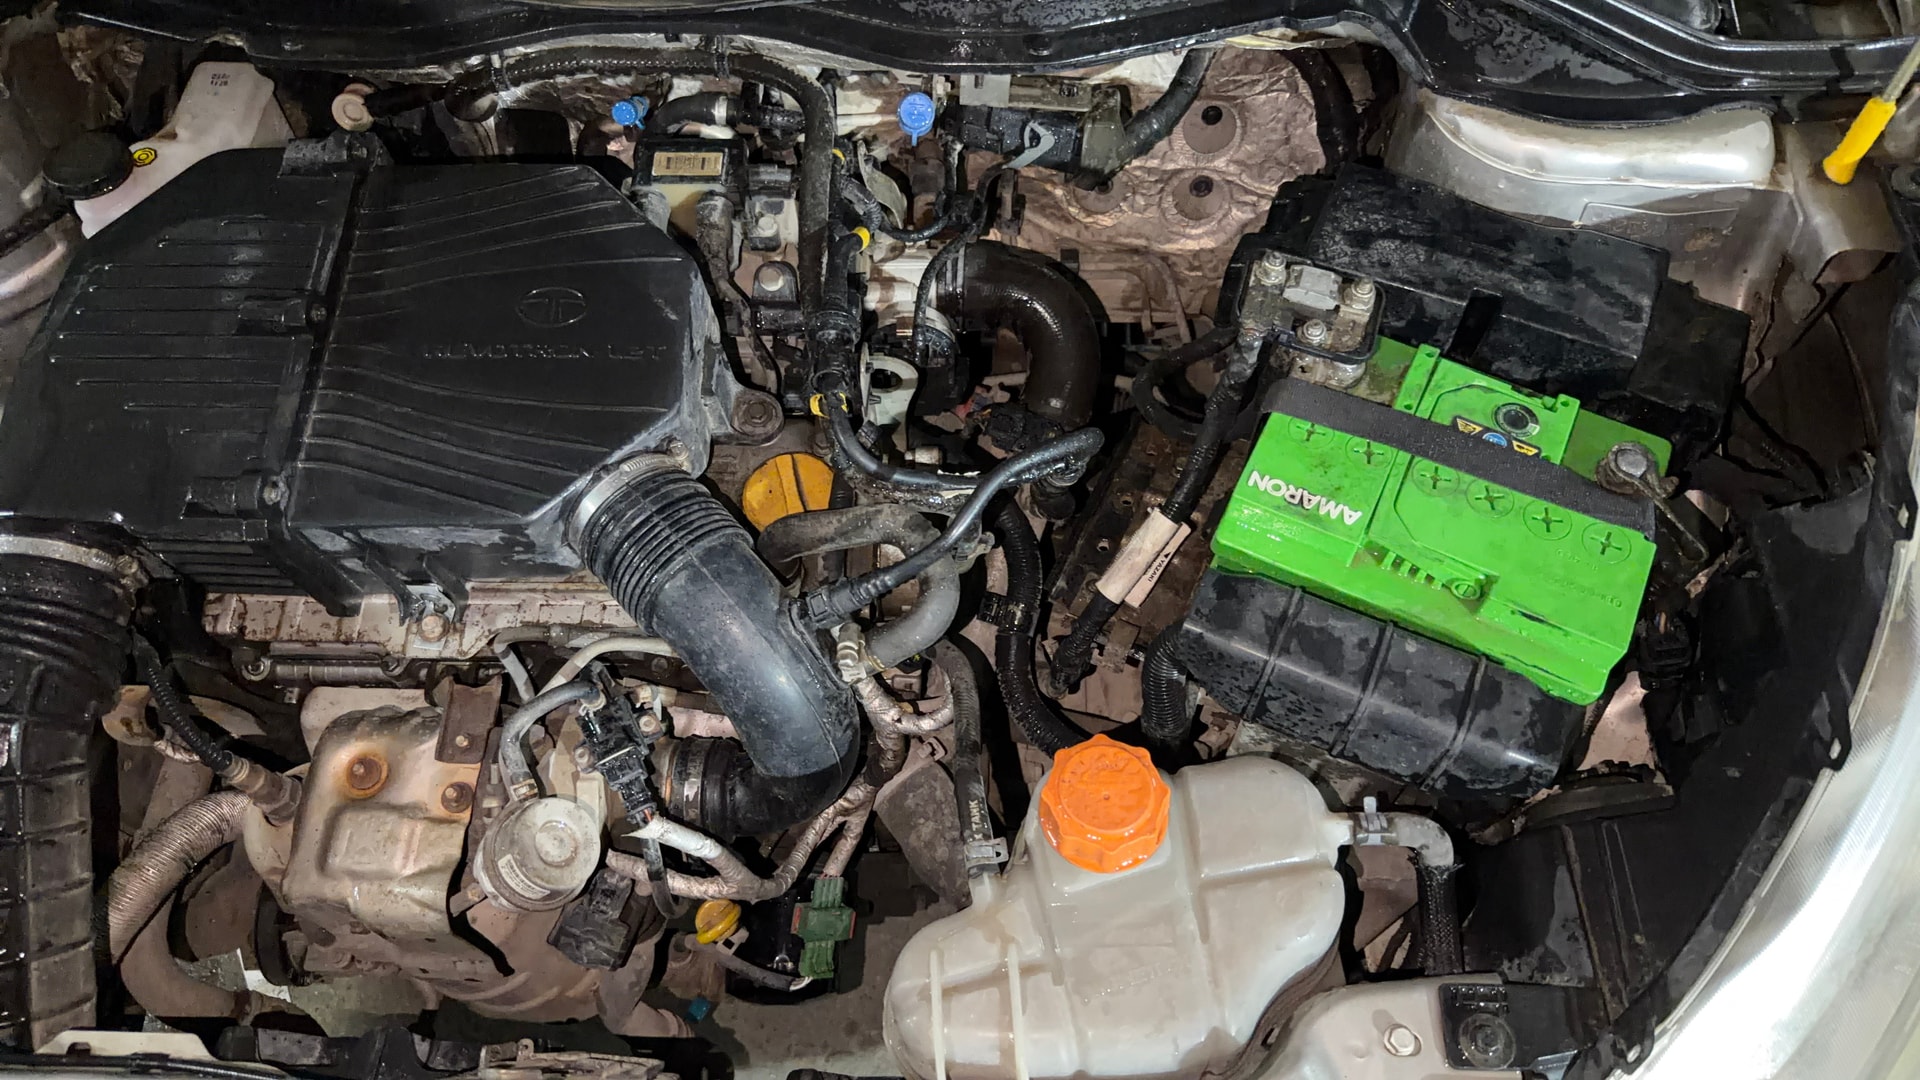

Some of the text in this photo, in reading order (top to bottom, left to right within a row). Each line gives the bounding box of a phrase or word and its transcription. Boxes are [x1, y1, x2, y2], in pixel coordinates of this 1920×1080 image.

[1247, 470, 1363, 526] AMARON
[1147, 559, 1167, 583] YAZAKI
[968, 799, 983, 832] TANK
